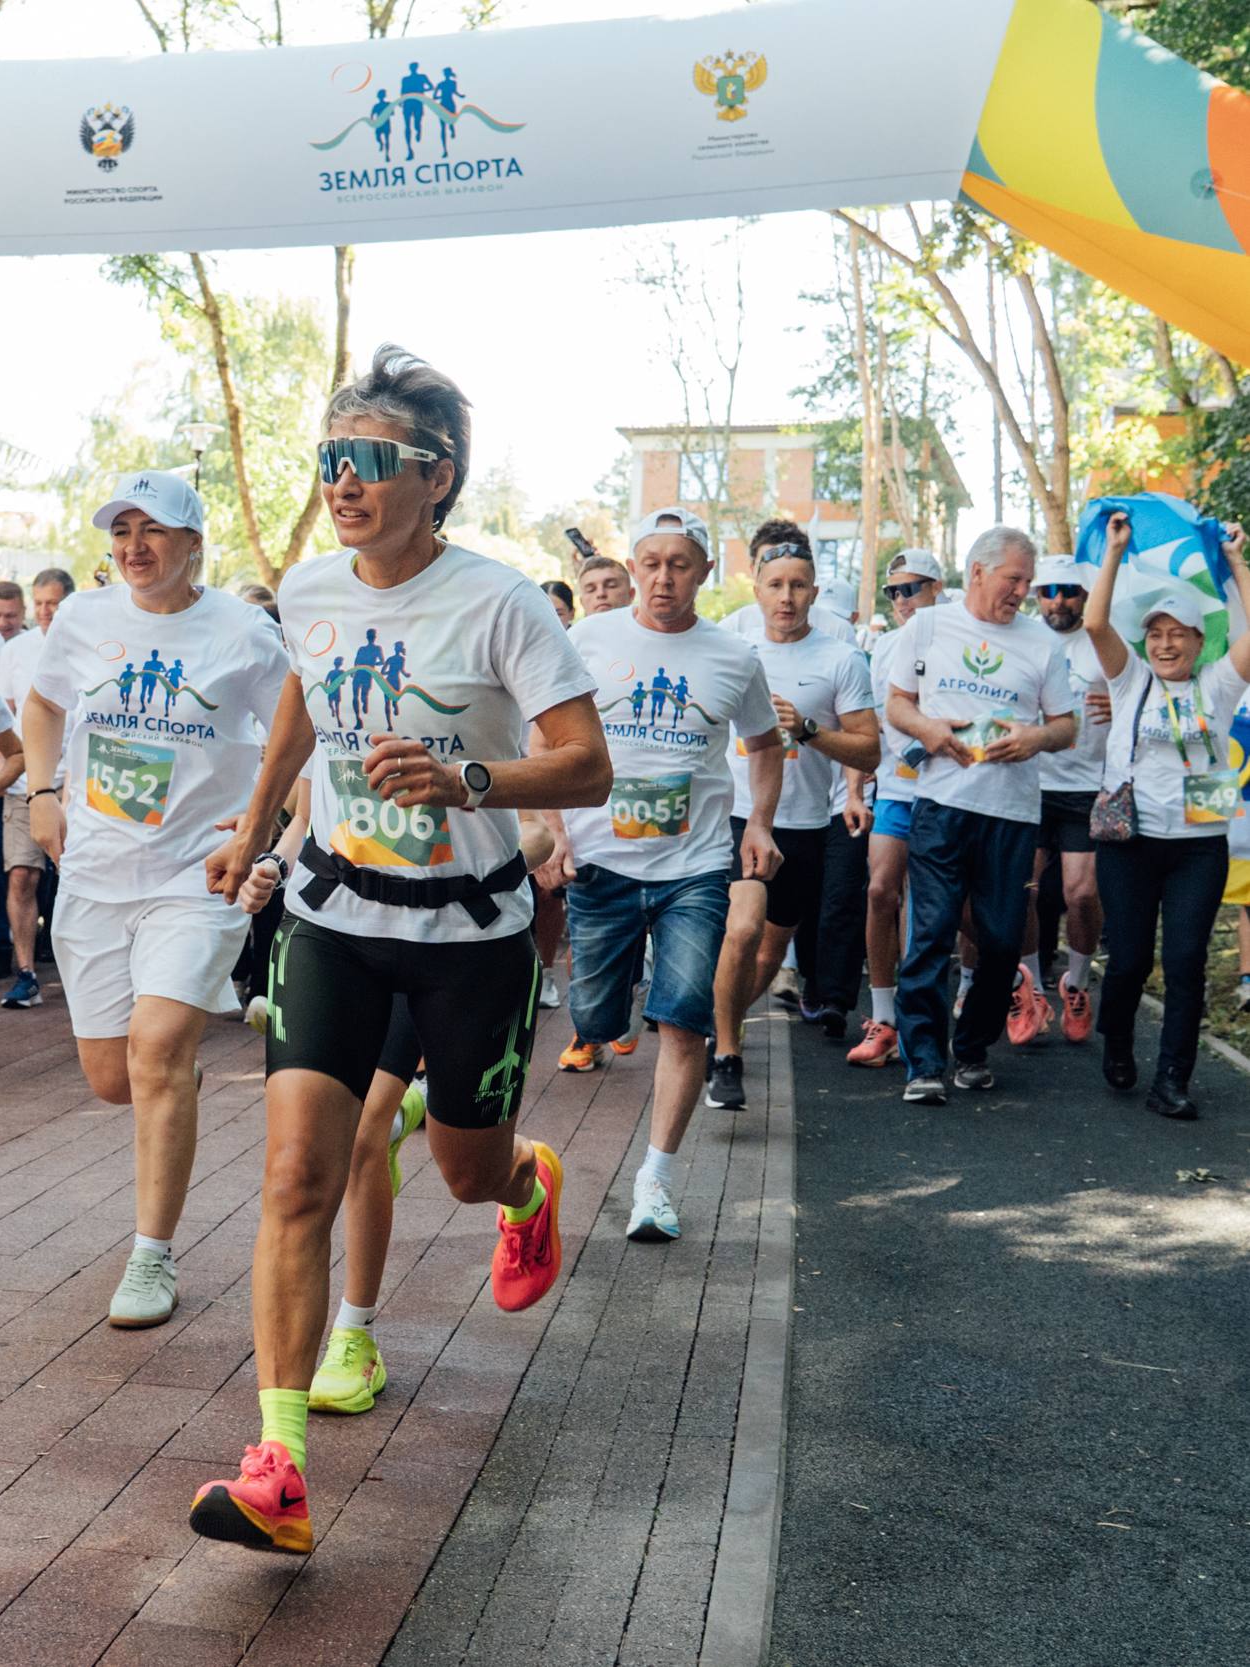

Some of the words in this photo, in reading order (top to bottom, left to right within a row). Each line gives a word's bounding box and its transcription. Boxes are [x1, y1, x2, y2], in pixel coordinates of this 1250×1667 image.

[319, 166, 406, 191] ЗЕМЛЯ
[414, 157, 524, 184] СПОРТА
[938, 677, 1019, 702] АГРОЛИГА
[144, 717, 215, 739] СПОРТА
[604, 723, 648, 739] ЕМЛЯ
[91, 762, 159, 805] 1552
[613, 794, 688, 824] 0055
